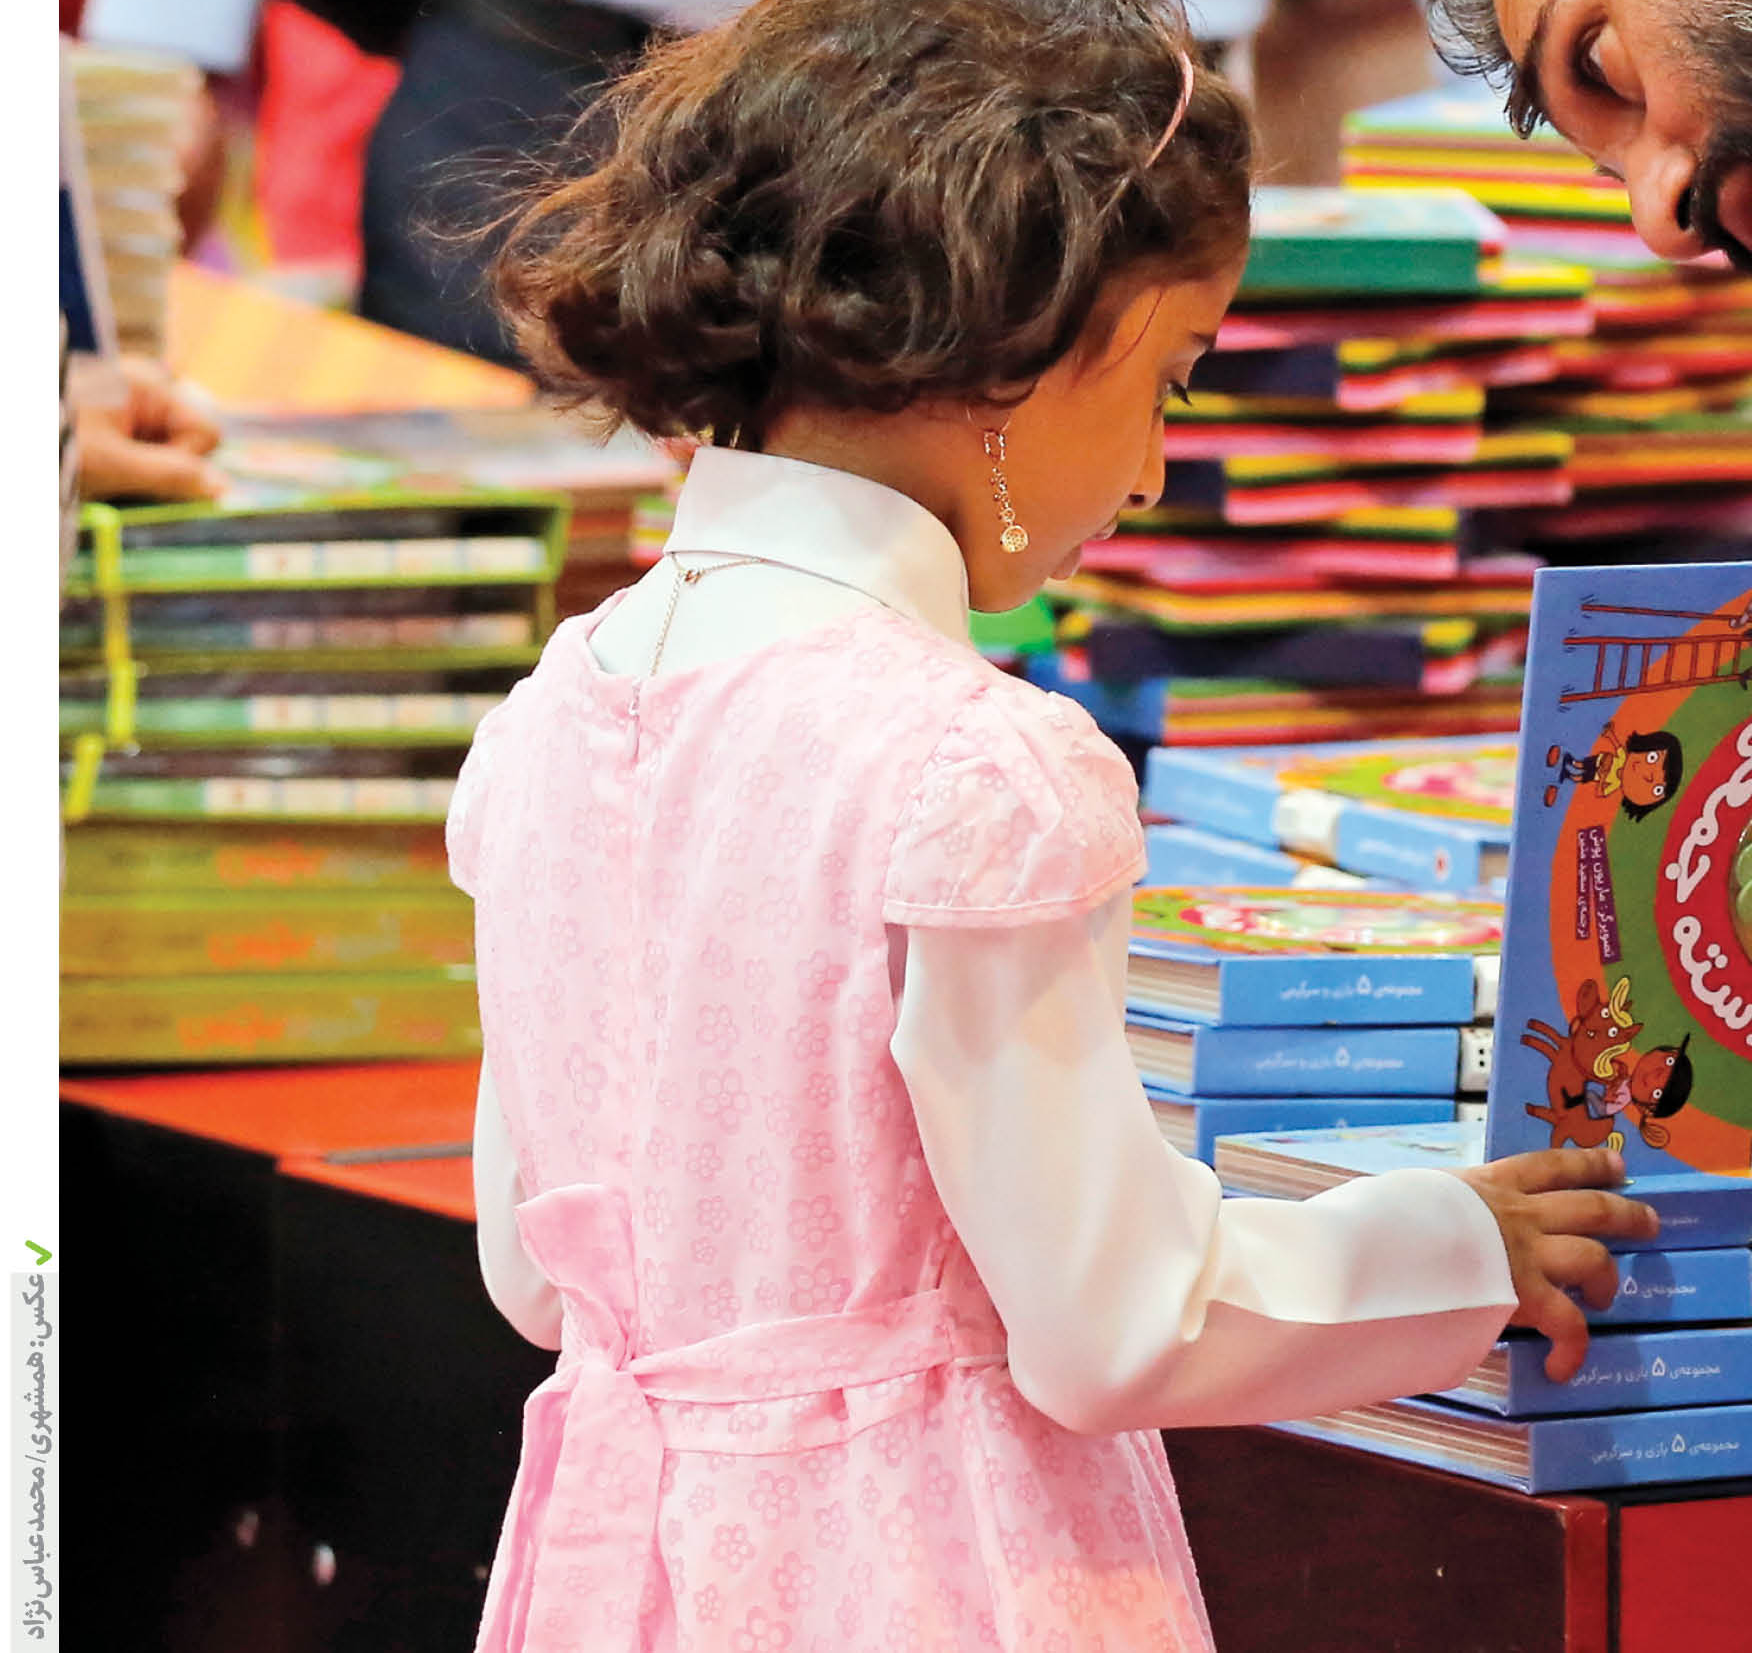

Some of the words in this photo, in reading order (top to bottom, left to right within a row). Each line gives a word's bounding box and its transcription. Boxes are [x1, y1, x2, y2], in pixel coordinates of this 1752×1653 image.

[1623, 1276, 1638, 1295] ۵
[1652, 1356, 1666, 1377] ۵
[1671, 1433, 1686, 1453] ۵
